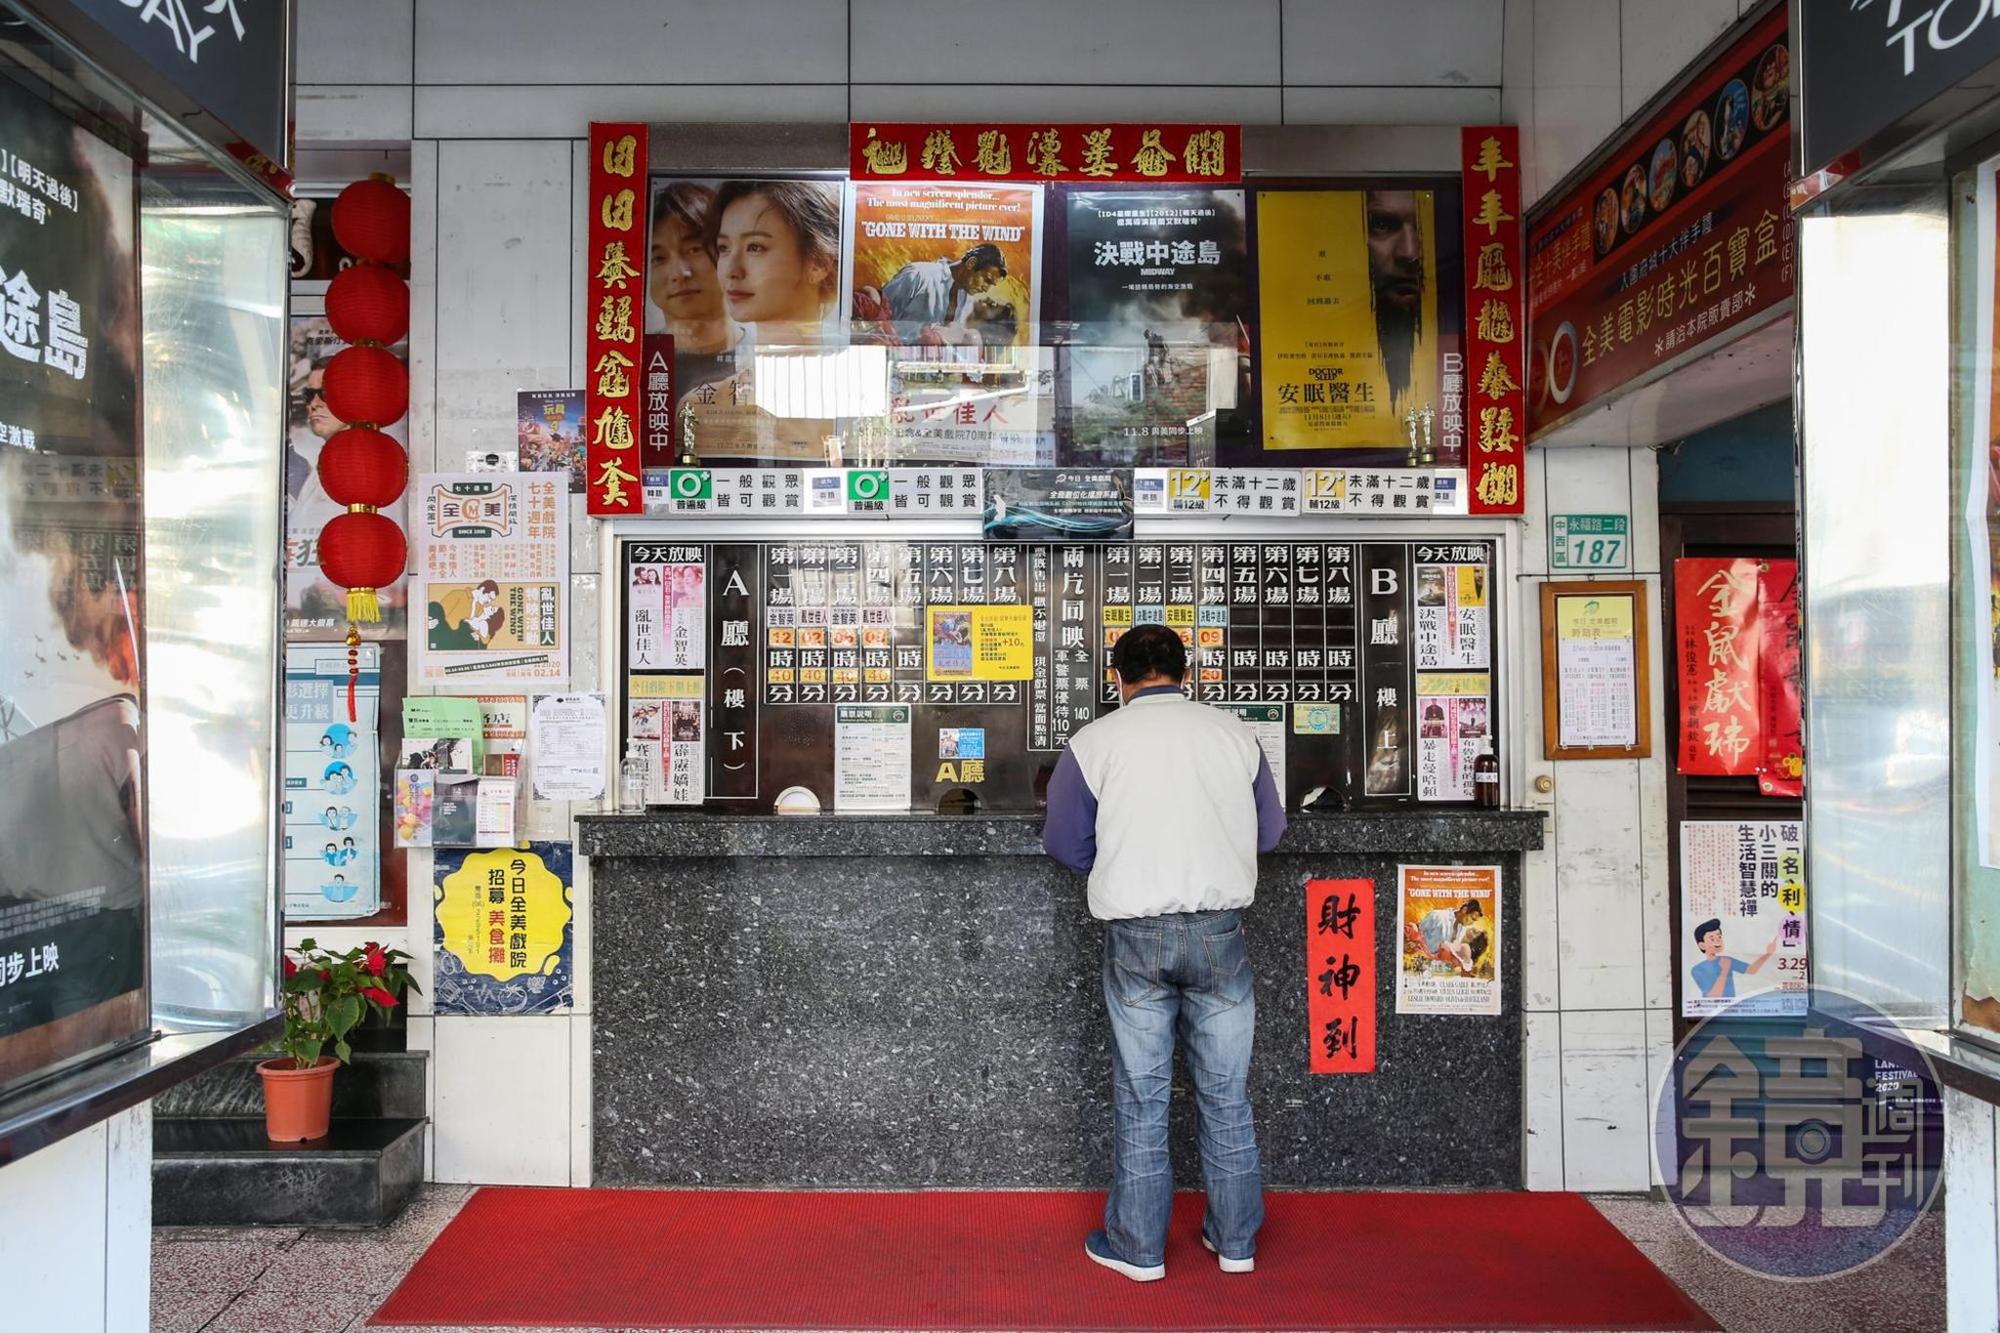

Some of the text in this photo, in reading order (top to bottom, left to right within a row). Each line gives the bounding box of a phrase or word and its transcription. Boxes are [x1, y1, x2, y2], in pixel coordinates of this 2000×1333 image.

[119, 0, 215, 63] AY
[1886, 0, 2000, 76] TO
[866, 198, 1020, 212] The most magnificent picture ever!
[923, 190, 949, 198] screen
[908, 223, 946, 239] WITH
[949, 225, 980, 241] THE
[1094, 240, 1221, 266] 決戰中途島
[1140, 268, 1175, 276] MIDWAY
[1582, 209, 1780, 368] 全美電影時光百寶盒
[648, 350, 670, 452] A廳放映中
[1278, 382, 1375, 406] 安眠醫生
[1442, 353, 1464, 453] B廳放映中
[1123, 427, 1149, 437] 11.8
[716, 474, 799, 489] 一般觀眾
[894, 474, 977, 489] 一般觀眾
[1214, 475, 1297, 492] 未滿十二歲
[1349, 474, 1430, 490] 未滿十二歲
[528, 482, 541, 539] 七十週年
[543, 482, 556, 539] 全美戲院
[676, 500, 707, 510] 普遍級
[716, 493, 799, 508] 皆可觀賞
[853, 501, 885, 511] 普遍級
[894, 493, 977, 508] 皆可觀賞
[1214, 493, 1296, 511] 不得觀賞
[1348, 492, 1429, 509] 不得觀賞
[1568, 517, 1625, 532] 永福路二段
[634, 546, 703, 563] 今天放映
[1416, 546, 1486, 562] 今天放映
[1555, 519, 1566, 563] 中西區
[1574, 540, 1621, 564] 187
[771, 546, 795, 604] 第一場
[867, 546, 890, 604] 第四場
[899, 546, 922, 603] 第五場
[930, 546, 953, 602] 第六場
[961, 546, 985, 602] 第七場
[993, 546, 1017, 602] 第八場
[1106, 546, 1131, 604] 第一場
[1138, 546, 1162, 604] 第二場
[1169, 546, 1194, 604] 第三場
[1201, 546, 1226, 604] 第四場
[1232, 546, 1257, 604] 第五場
[1264, 546, 1289, 604] 第六場
[1296, 546, 1320, 604] 第七場
[1326, 546, 1351, 604] 第八場
[1062, 546, 1086, 648] 兩片同映
[541, 587, 555, 645] 亂世佳人
[635, 609, 652, 665] 亂世佳人
[1419, 608, 1438, 666] 決戰中途島
[1459, 608, 1476, 665] 安眠醫生
[770, 650, 793, 668] 時
[801, 650, 825, 668] 時
[833, 650, 856, 668] 時
[865, 650, 889, 668] 時
[1202, 650, 1225, 667] 時
[1697, 569, 1752, 767] 金鼠獻瑞
[898, 650, 921, 702] 時 分
[1234, 650, 1258, 701] 時 分
[1265, 650, 1290, 701] 時 分
[1297, 650, 1321, 701] 時 分
[1328, 650, 1352, 701] 時 分
[769, 684, 793, 702] 分
[801, 684, 825, 702] 分
[834, 684, 857, 702] 分
[867, 684, 890, 702] 分
[930, 684, 953, 702] 分
[961, 684, 985, 702] 分
[993, 684, 1017, 702] 分
[1203, 683, 1226, 701] 分
[1074, 707, 1090, 721] 140
[935, 759, 986, 783] A廳
[1738, 824, 1758, 917] 生活智慧禪
[1759, 824, 1779, 898] 小三關的
[488, 869, 505, 904] 招募
[510, 859, 527, 968] 今日全美戲院
[1318, 893, 1361, 1060] 財神到
[1778, 958, 1808, 970] 3.29
[1875, 1070, 1918, 1080] FESTIVAL
